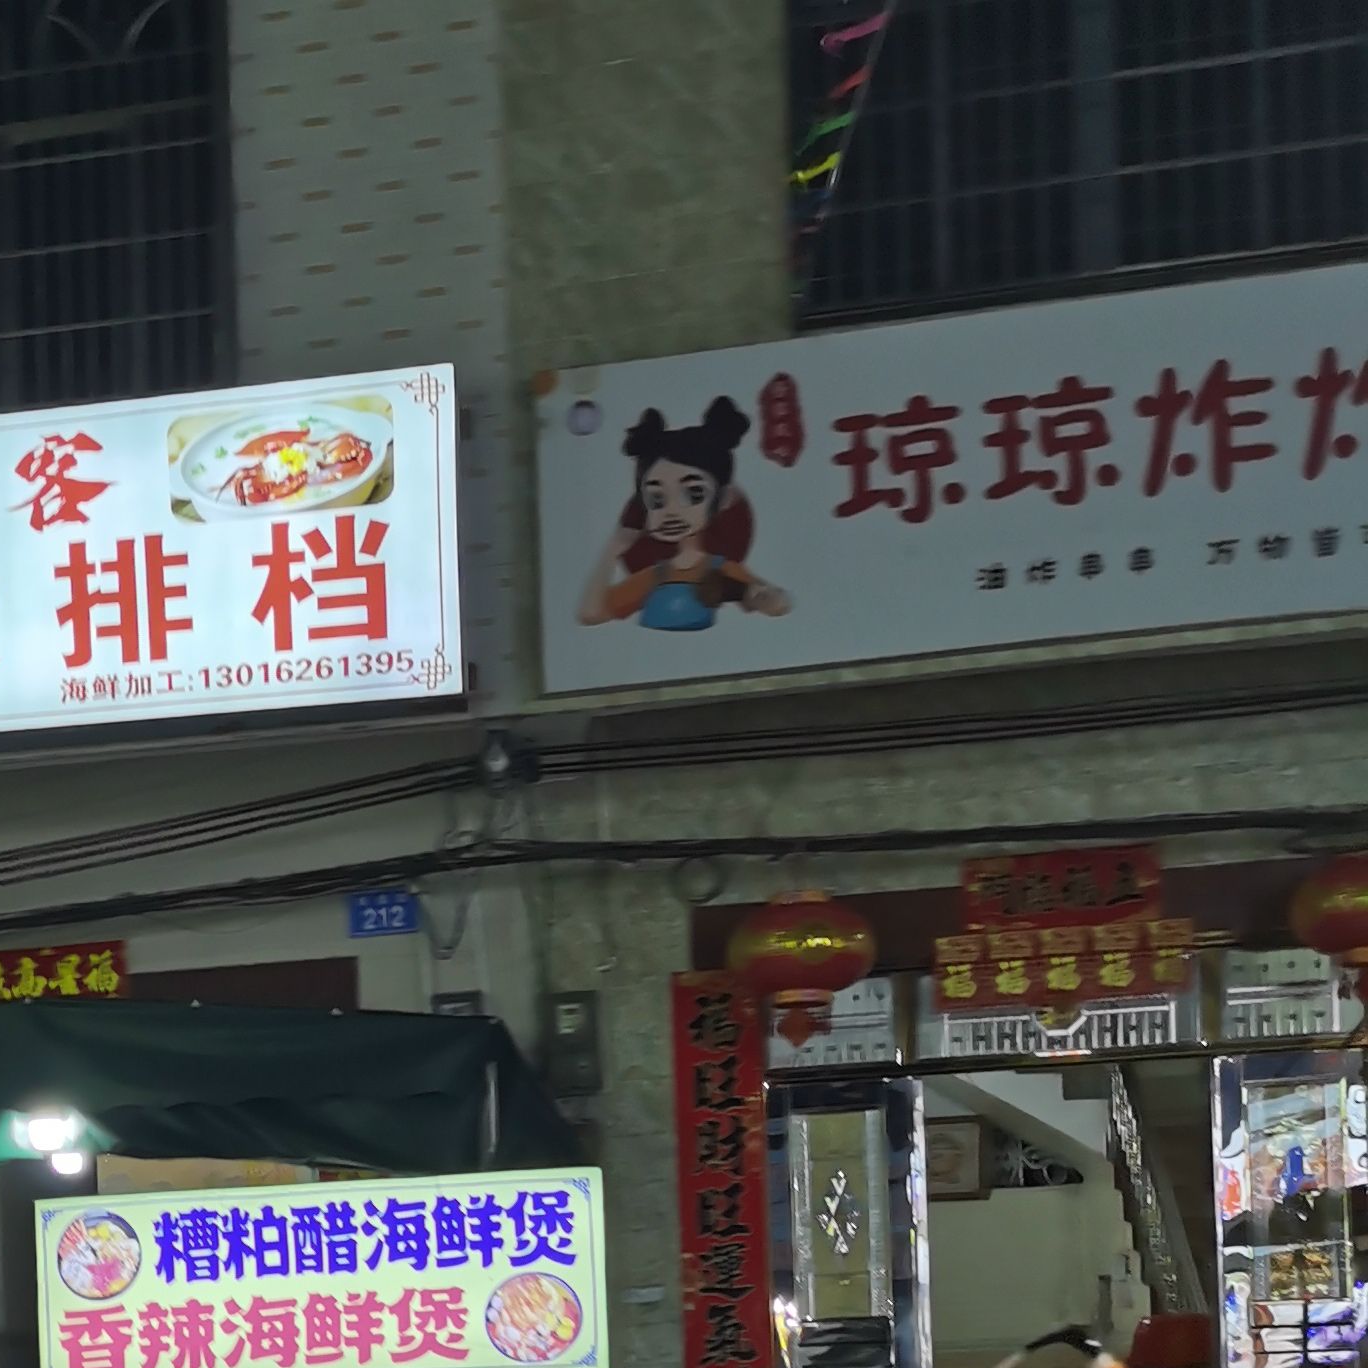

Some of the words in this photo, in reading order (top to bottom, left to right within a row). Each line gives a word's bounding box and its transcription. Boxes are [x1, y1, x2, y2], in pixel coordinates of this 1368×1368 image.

[1206, 524, 1368, 567] 万物皆
[362, 904, 405, 930] 212
[154, 1190, 578, 1284] 糟粕醋海鲜煲
